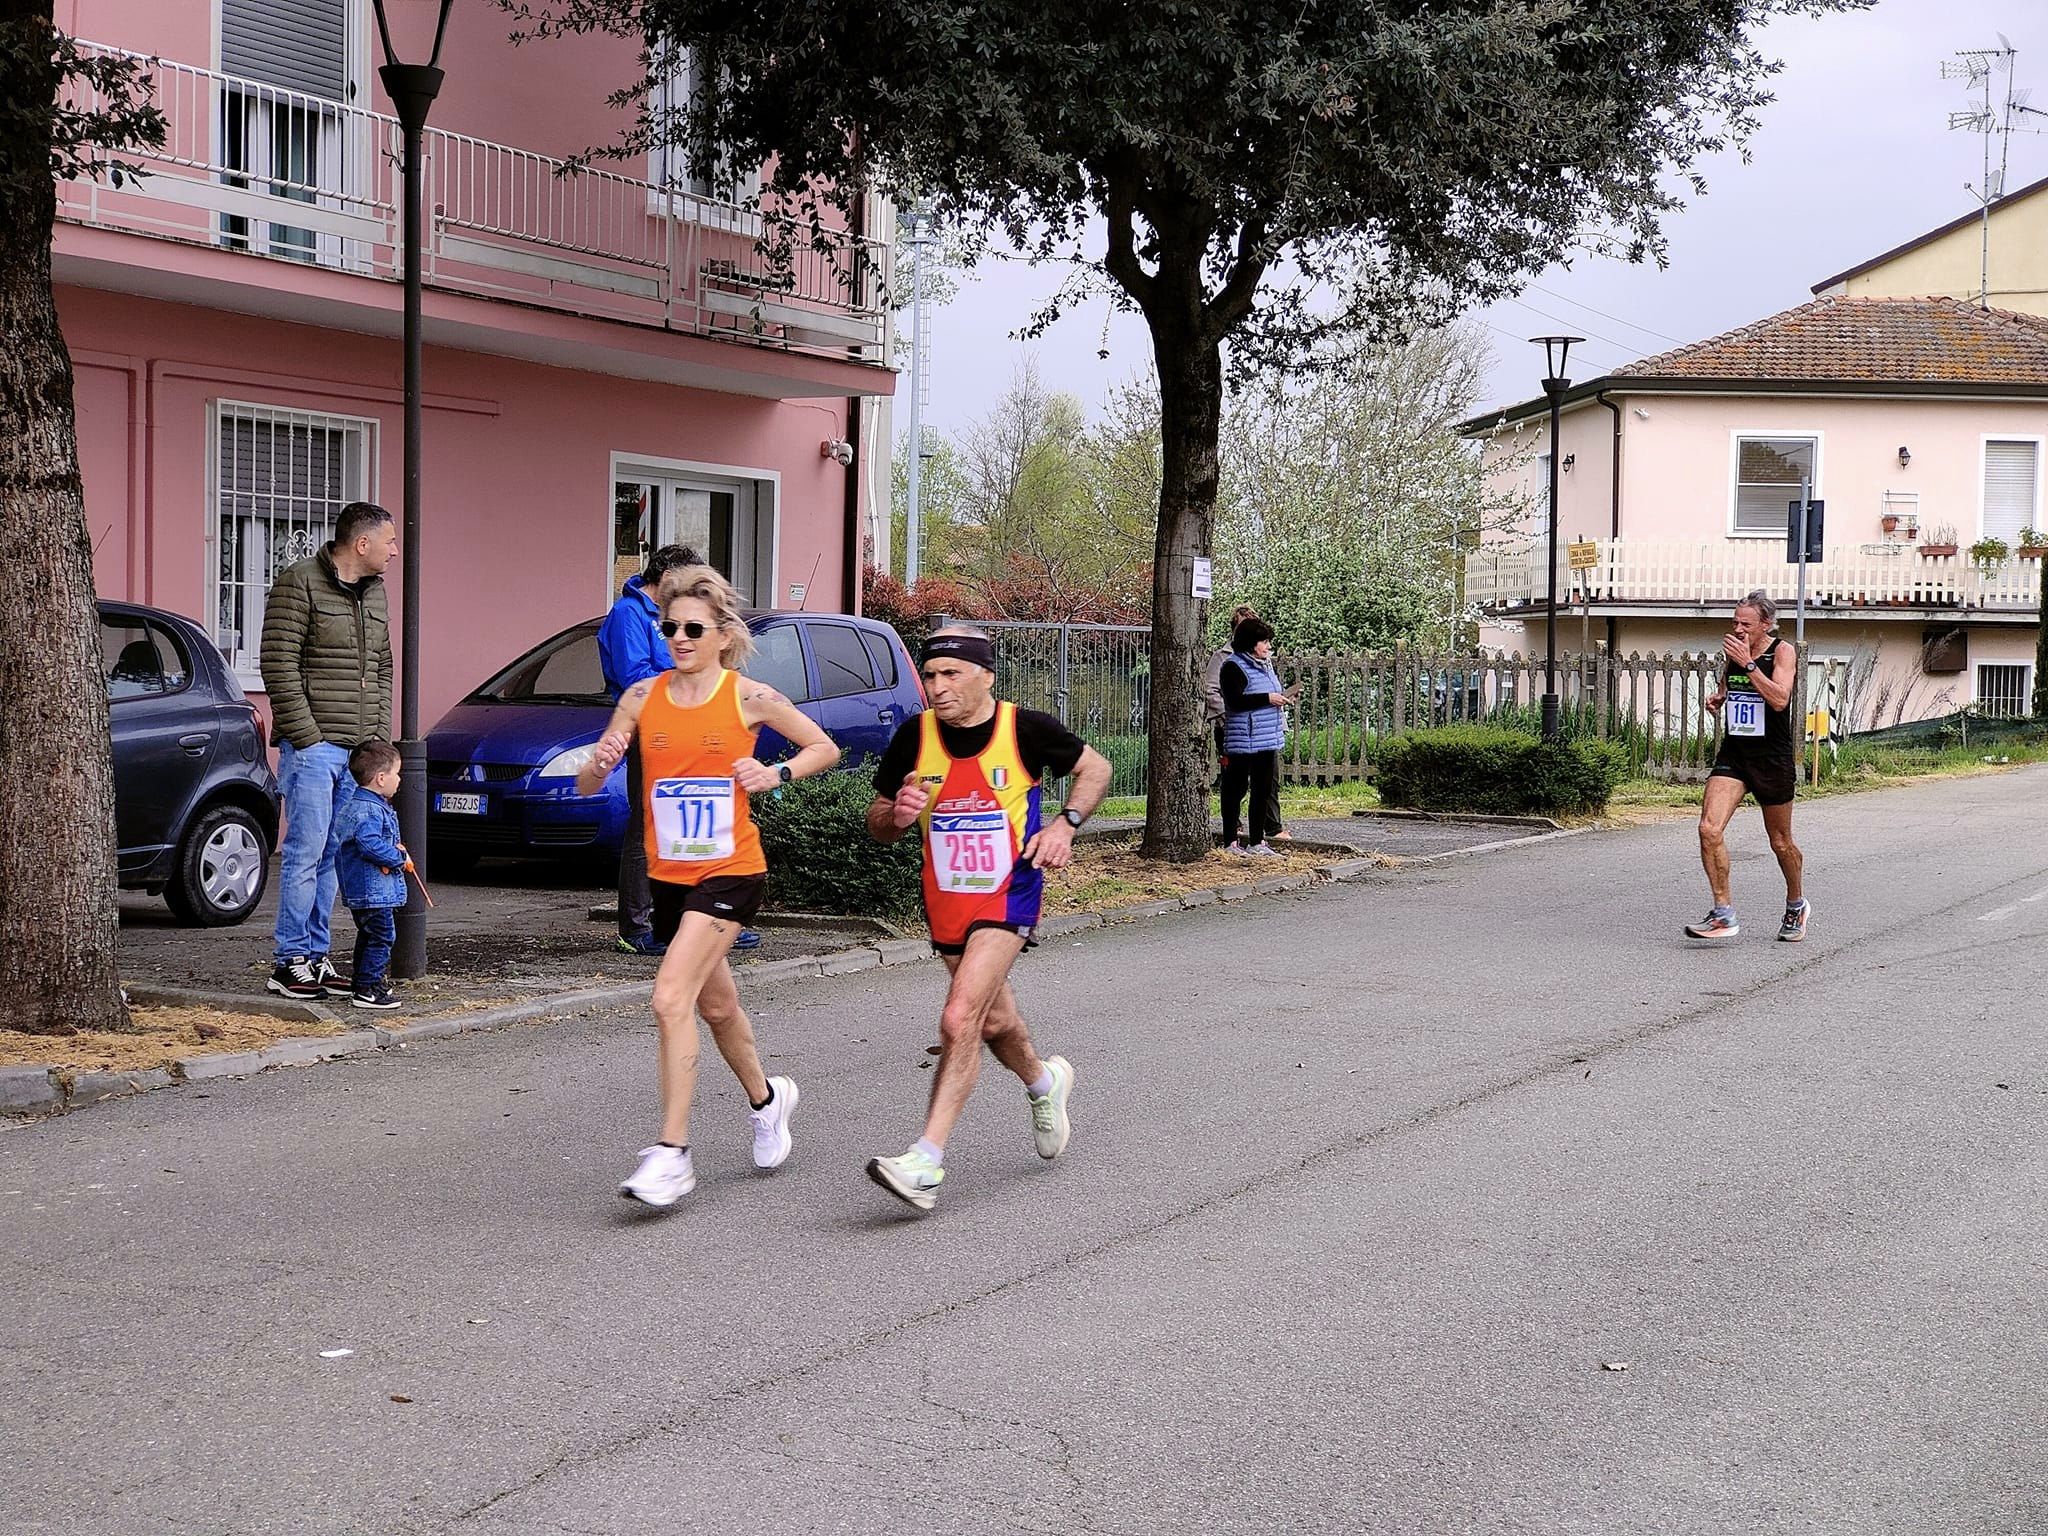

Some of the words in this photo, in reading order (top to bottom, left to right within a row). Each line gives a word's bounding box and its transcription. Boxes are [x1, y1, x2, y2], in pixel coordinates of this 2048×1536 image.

[1734, 703, 1755, 725] 161
[678, 799, 714, 838] 171
[944, 833, 996, 873] 255
